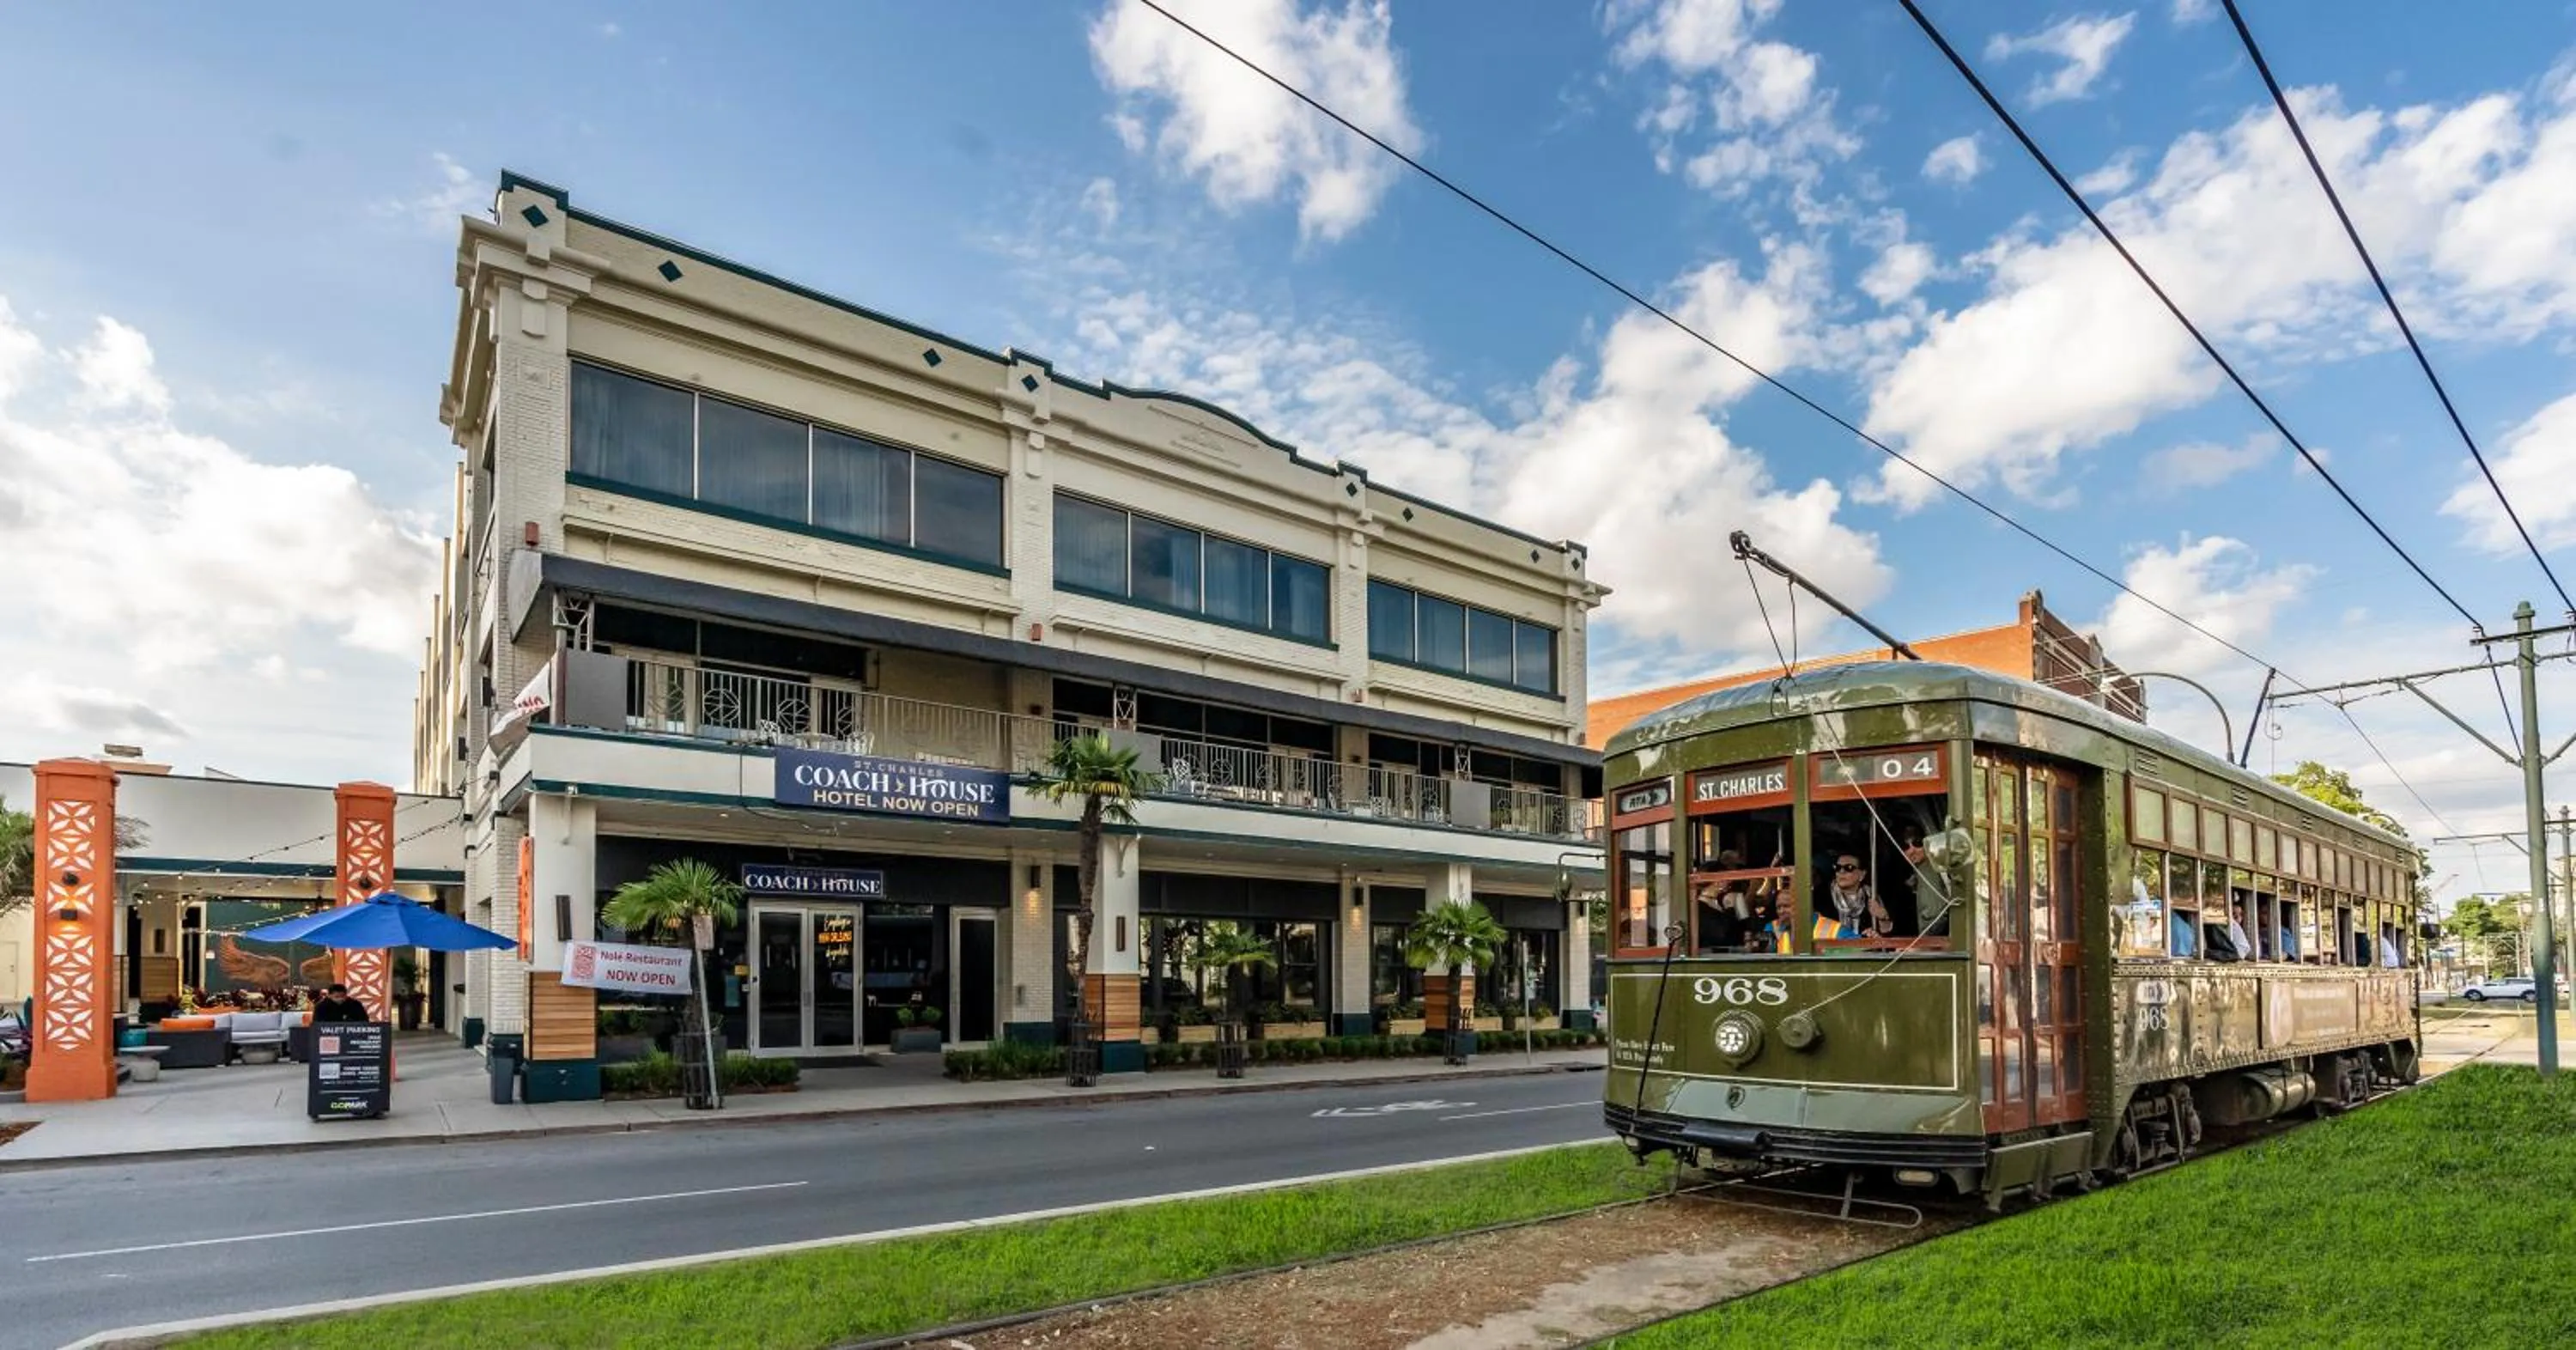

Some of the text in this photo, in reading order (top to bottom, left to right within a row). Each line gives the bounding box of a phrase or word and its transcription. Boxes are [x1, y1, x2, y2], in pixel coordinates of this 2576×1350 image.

[854, 760, 944, 777] ST. CHARLES
[794, 765, 994, 804] COACH HOUSE
[1699, 773, 1783, 800] ST. CHARLES
[813, 789, 978, 817] HOTEL NOW OPEN
[744, 873, 880, 894] COACH HOUSE
[626, 952, 683, 967] Restaurant
[606, 970, 676, 985] NOW OPEN
[1694, 977, 1789, 1006] 968
